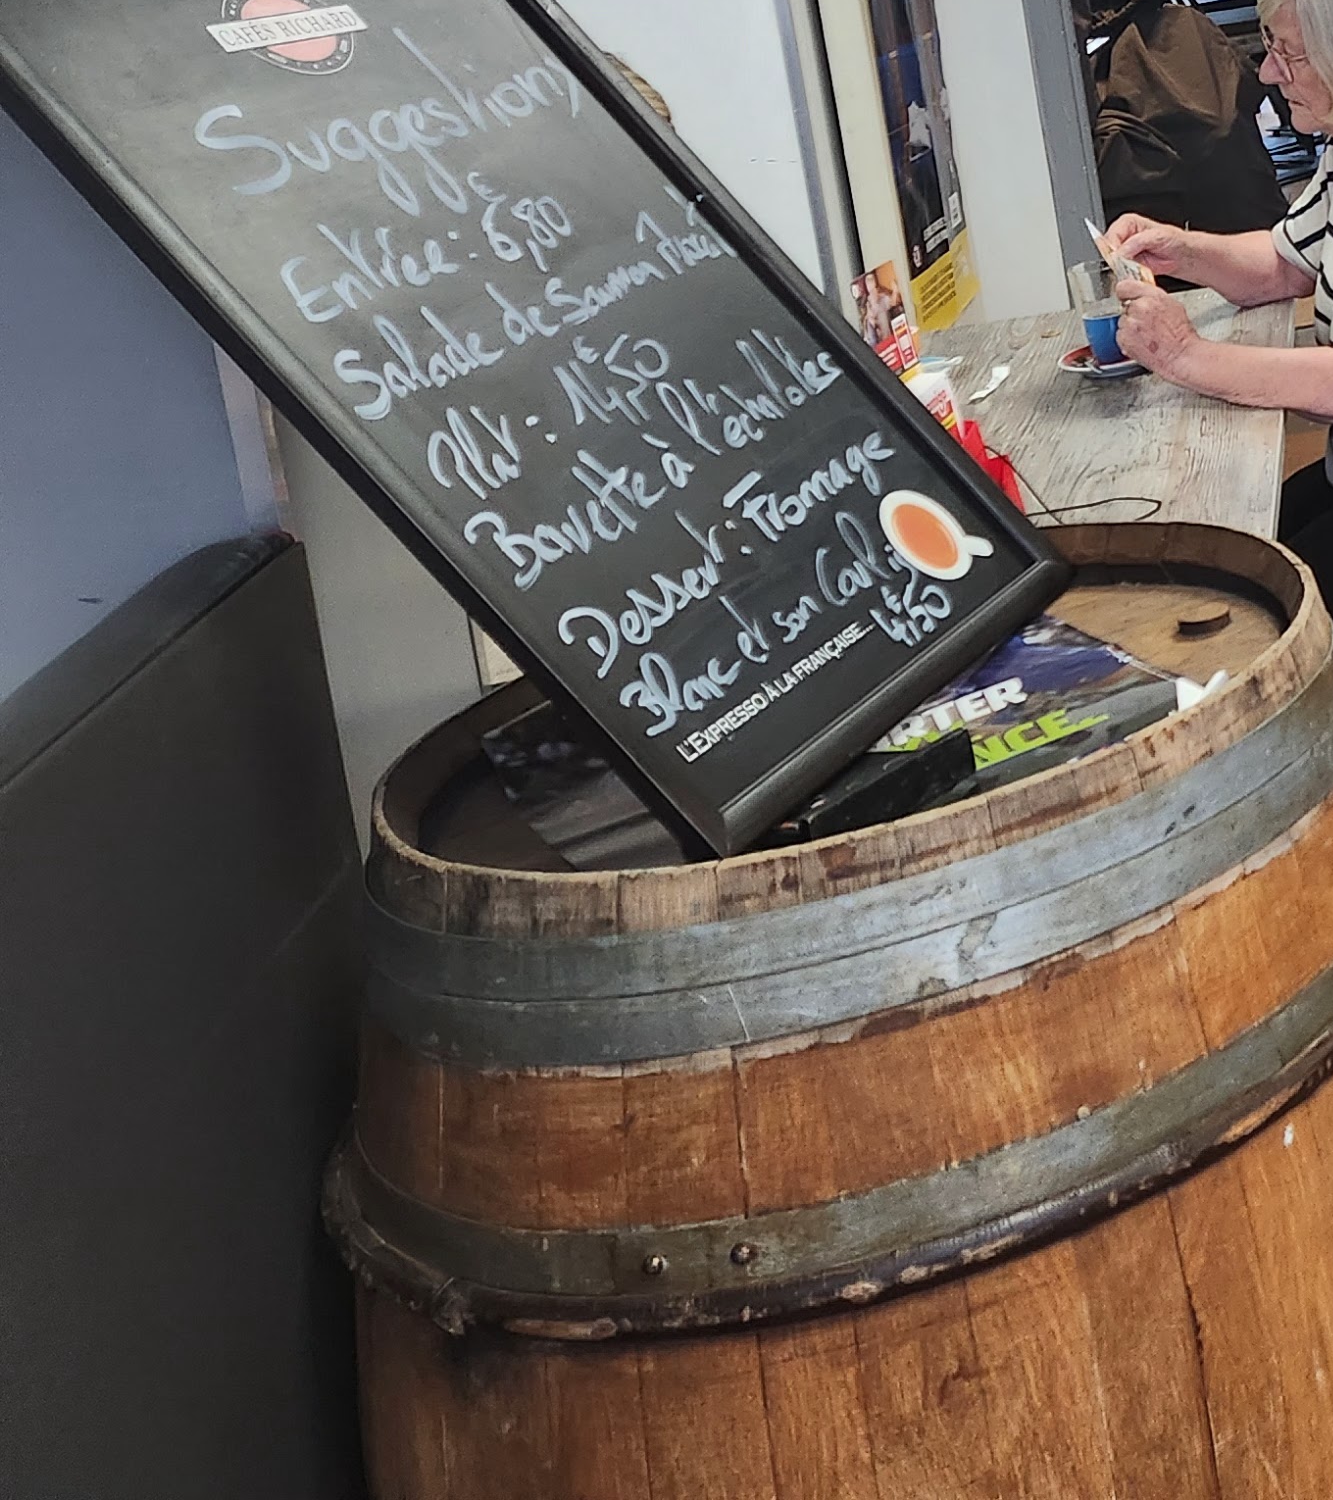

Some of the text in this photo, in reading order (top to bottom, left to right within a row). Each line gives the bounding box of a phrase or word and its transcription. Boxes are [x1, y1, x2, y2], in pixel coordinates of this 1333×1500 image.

[275, 10, 358, 38] RICHARD
[332, 304, 505, 421] Salade
[485, 281, 561, 346] de
[463, 448, 668, 591] Bavette
[640, 432, 696, 489] à
[723, 430, 897, 542] Fromage
[619, 651, 742, 738] Blanc
[772, 594, 822, 644] son
[675, 692, 769, 764] L'EXPRESSO
[761, 681, 781, 703] À
[773, 671, 799, 695] LA
